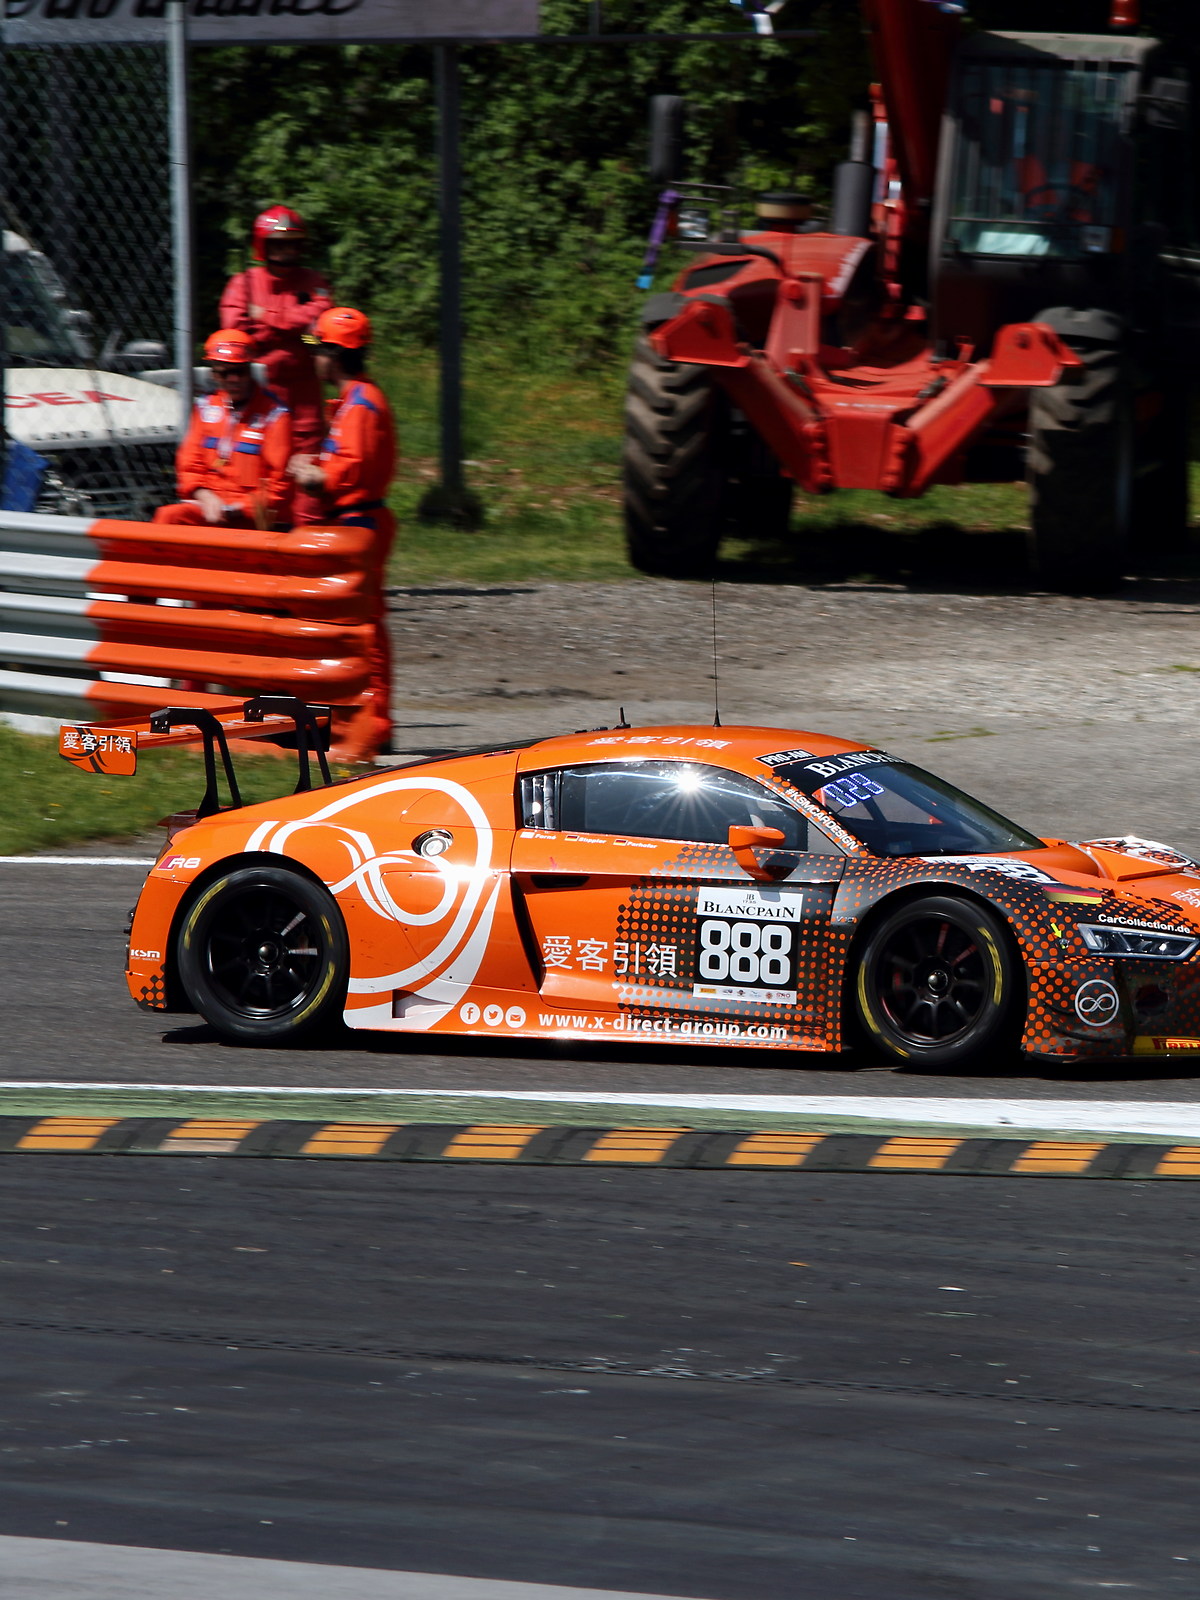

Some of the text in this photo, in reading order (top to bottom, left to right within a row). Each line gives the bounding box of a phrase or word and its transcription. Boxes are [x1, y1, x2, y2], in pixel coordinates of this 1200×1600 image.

[63, 732, 132, 754] 愛客引領
[760, 750, 813, 766] PRO-AM
[785, 788, 859, 851] #KSMCARDESIGN
[167, 857, 201, 869] R8
[703, 900, 796, 919] BLANCPAIN
[1098, 914, 1191, 934] CarCollection.de
[542, 935, 678, 979] 愛客引領
[699, 919, 792, 985] 888
[538, 1013, 788, 1040] www.x-direct-group.com
